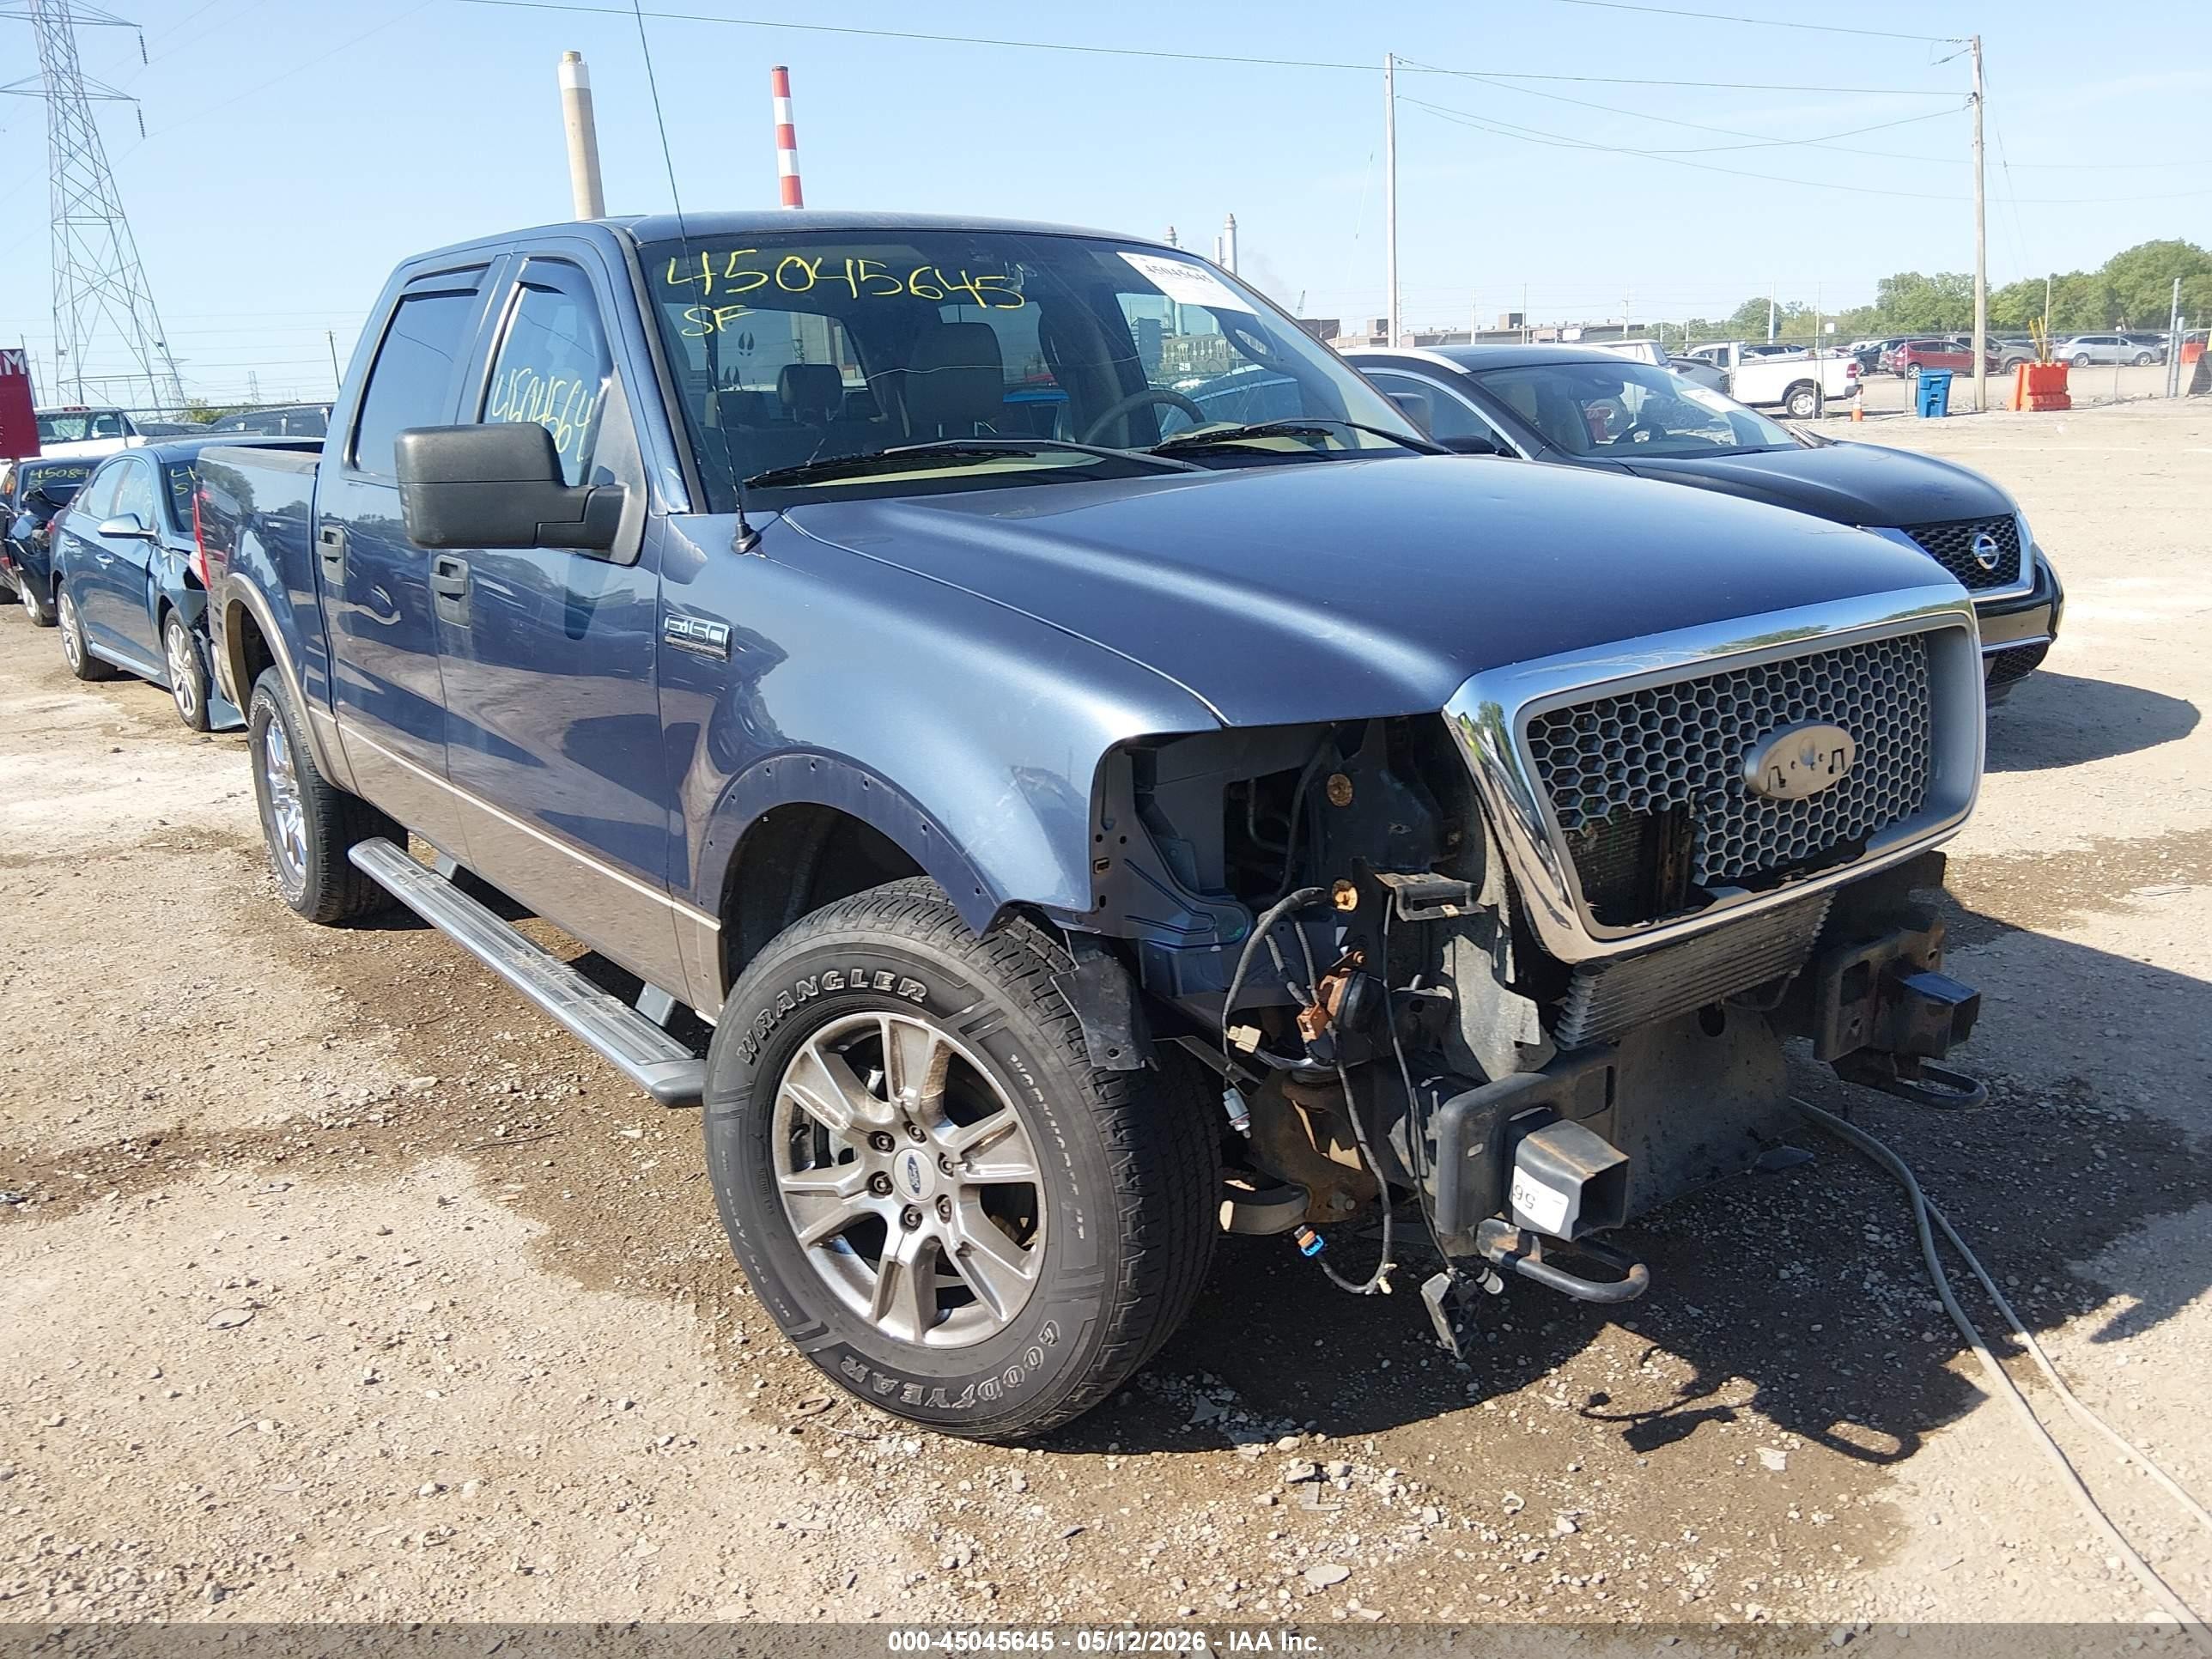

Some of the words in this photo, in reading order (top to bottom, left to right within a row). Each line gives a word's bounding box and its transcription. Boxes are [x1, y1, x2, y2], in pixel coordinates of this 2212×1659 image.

[666, 249, 1026, 309] 45045645
[681, 304, 757, 337] SF
[735, 968, 928, 1066] WRANGLER
[839, 1319, 1060, 1409] GOODYEAR
